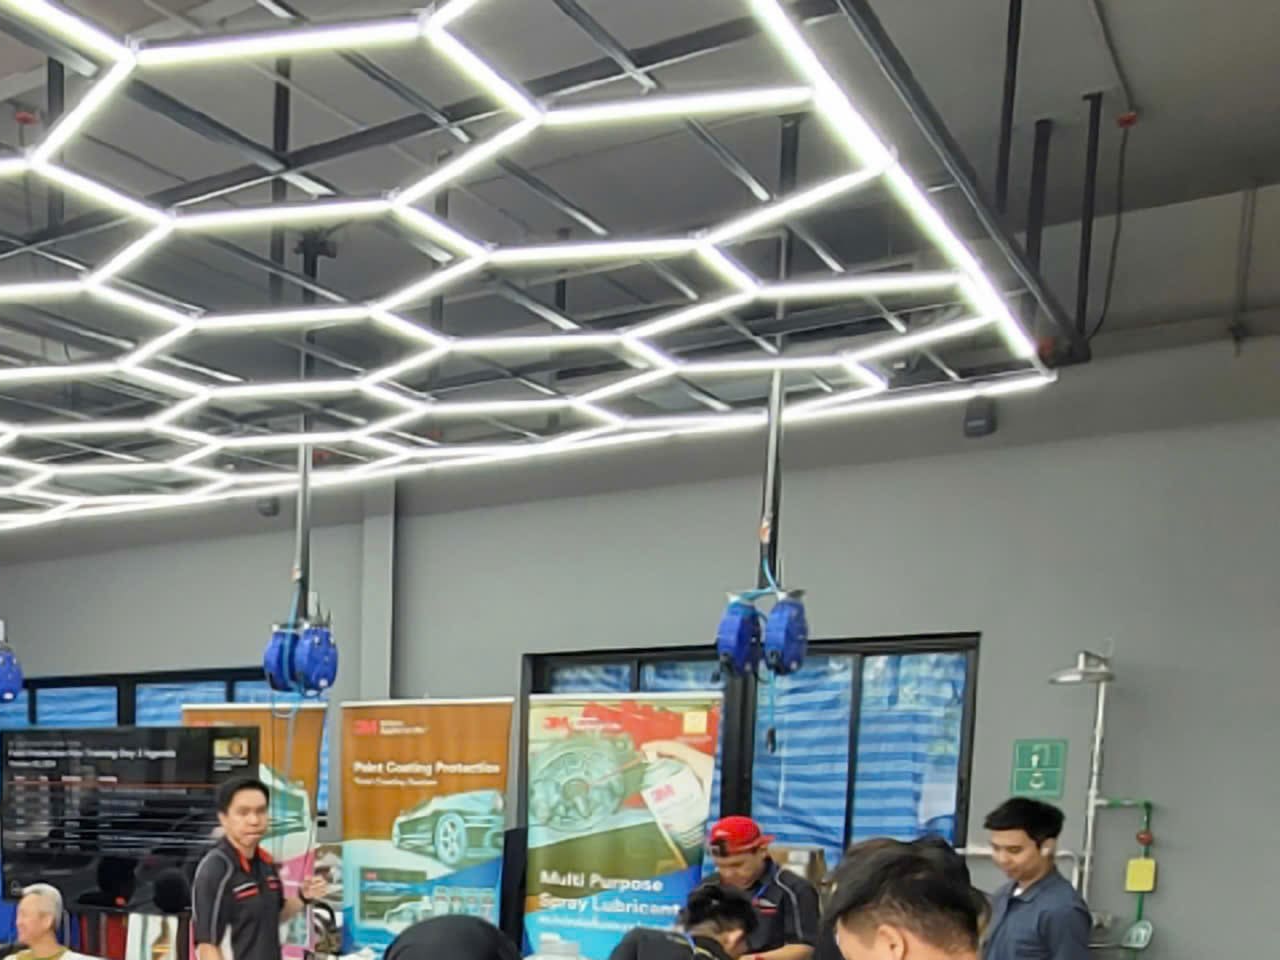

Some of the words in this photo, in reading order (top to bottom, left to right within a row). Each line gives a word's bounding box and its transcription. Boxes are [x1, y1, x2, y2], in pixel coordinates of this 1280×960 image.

[540, 870, 585, 888] Multi
[589, 872, 664, 892] Purpose
[592, 896, 681, 915] Lubricant
